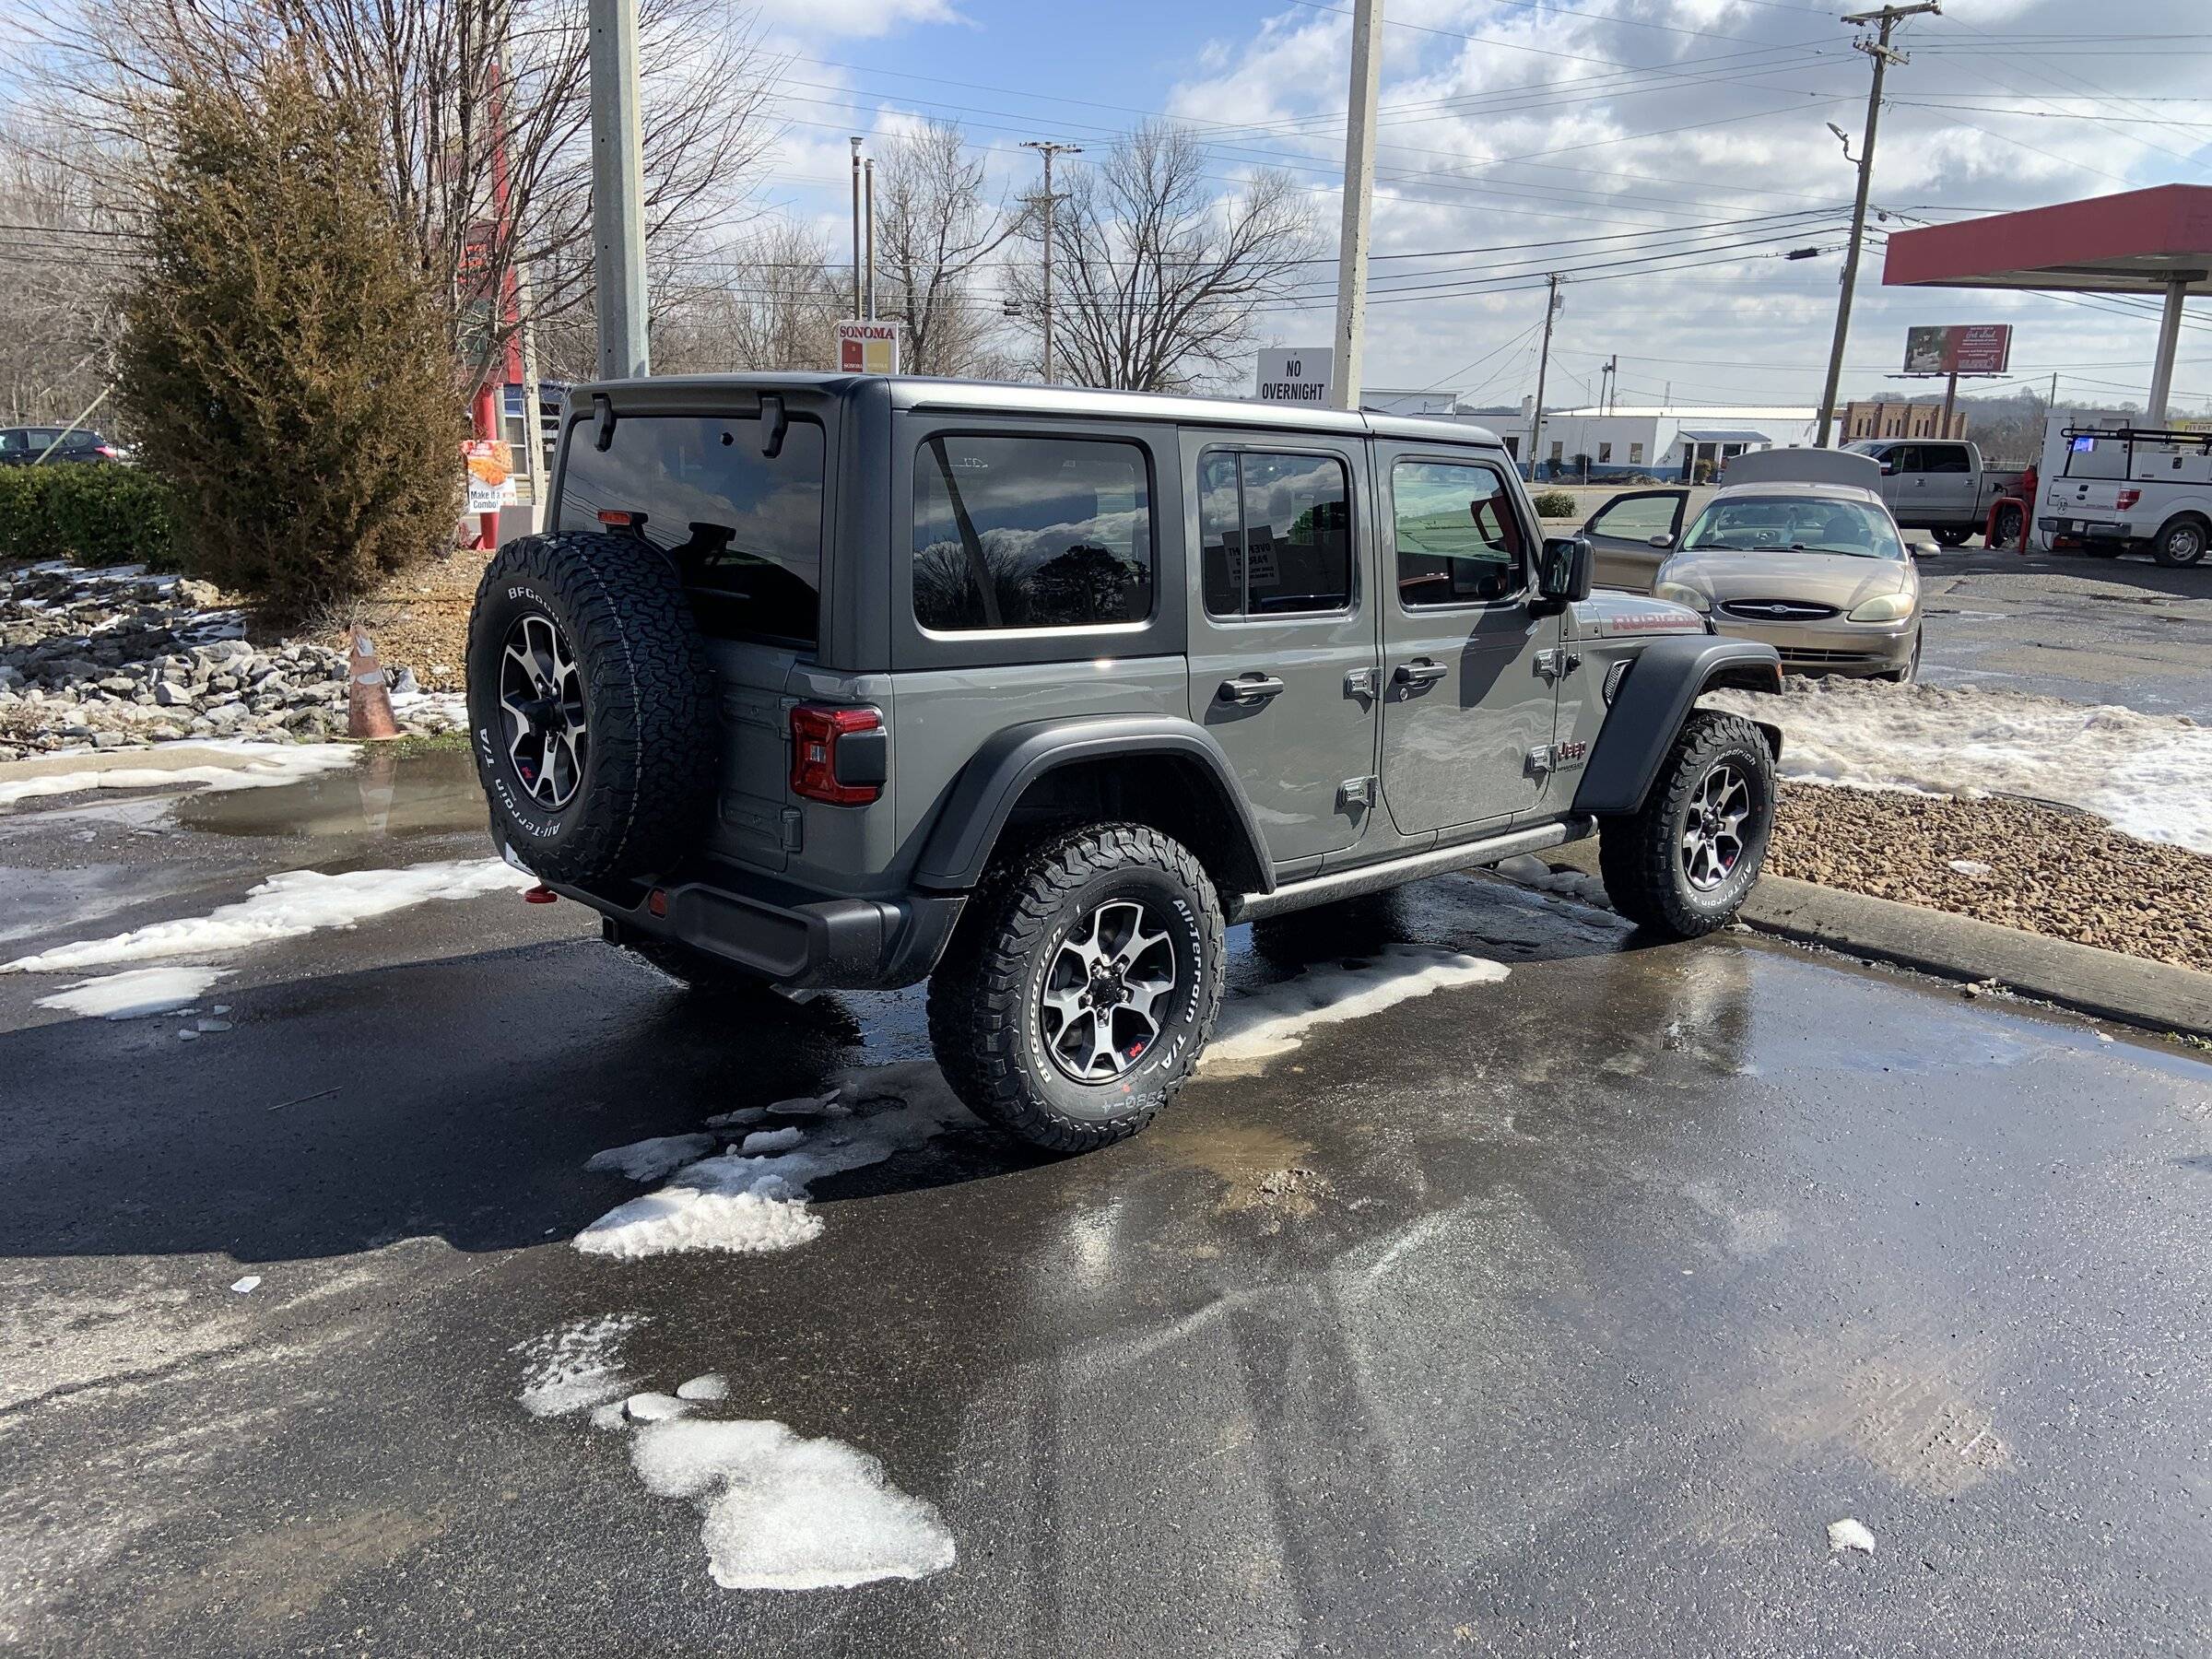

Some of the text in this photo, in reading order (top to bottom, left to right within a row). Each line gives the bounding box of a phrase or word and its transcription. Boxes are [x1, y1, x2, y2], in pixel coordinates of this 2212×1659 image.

[840, 326, 894, 339] SONOMA
[1287, 360, 1301, 377] NO
[1263, 382, 1324, 400] OVERNIGHT
[471, 490, 489, 500] Make
[473, 500, 499, 509] Combo!
[1612, 615, 1700, 630] RUBICON
[1558, 742, 1586, 761] Jeep
[479, 728, 561, 838] All-Terrain T/A
[1686, 861, 1751, 907] All-Terrain T/A
[1160, 899, 1202, 1071] All-Terrain T/A
[1030, 926, 1062, 1084] BFGoodrich
